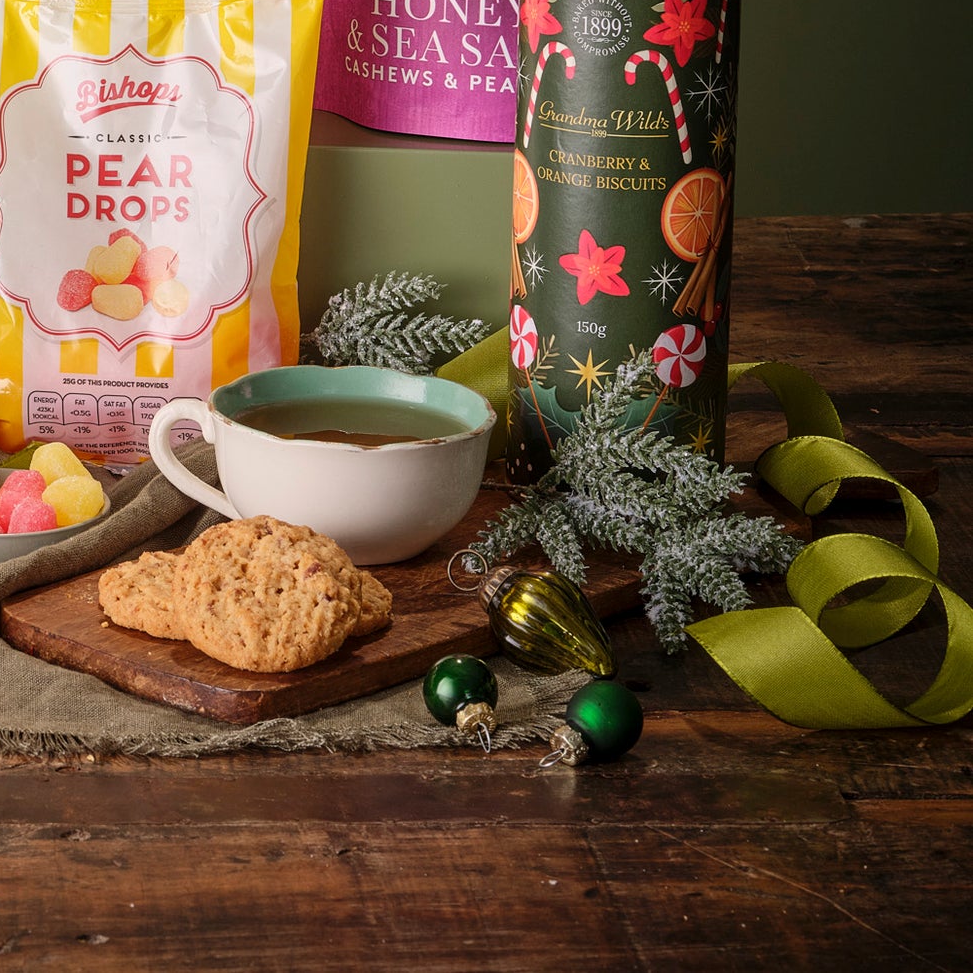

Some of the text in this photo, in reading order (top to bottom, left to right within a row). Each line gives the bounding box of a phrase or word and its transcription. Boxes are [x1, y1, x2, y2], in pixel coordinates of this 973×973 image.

[590, 10, 612, 18] SINCE
[582, 16, 622, 37] 1899
[347, 19, 518, 69] & SEA SA
[573, 31, 630, 56] COMPROMISE
[345, 56, 516, 93] CASHEWS & PEA
[75, 76, 183, 113] Bishops
[537, 100, 670, 131] Grandma Wild's
[96, 133, 162, 143] CLASSIC
[590, 129, 607, 139] 1899
[66, 153, 192, 188] PEAR
[549, 149, 651, 171] CRANBERRY &
[537, 166, 666, 191] ORANGE BISCUITS
[66, 192, 190, 223] DROPS
[576, 320, 607, 338] 150g
[39, 426, 55, 434] 5%
[177, 432, 194, 441] <1%
